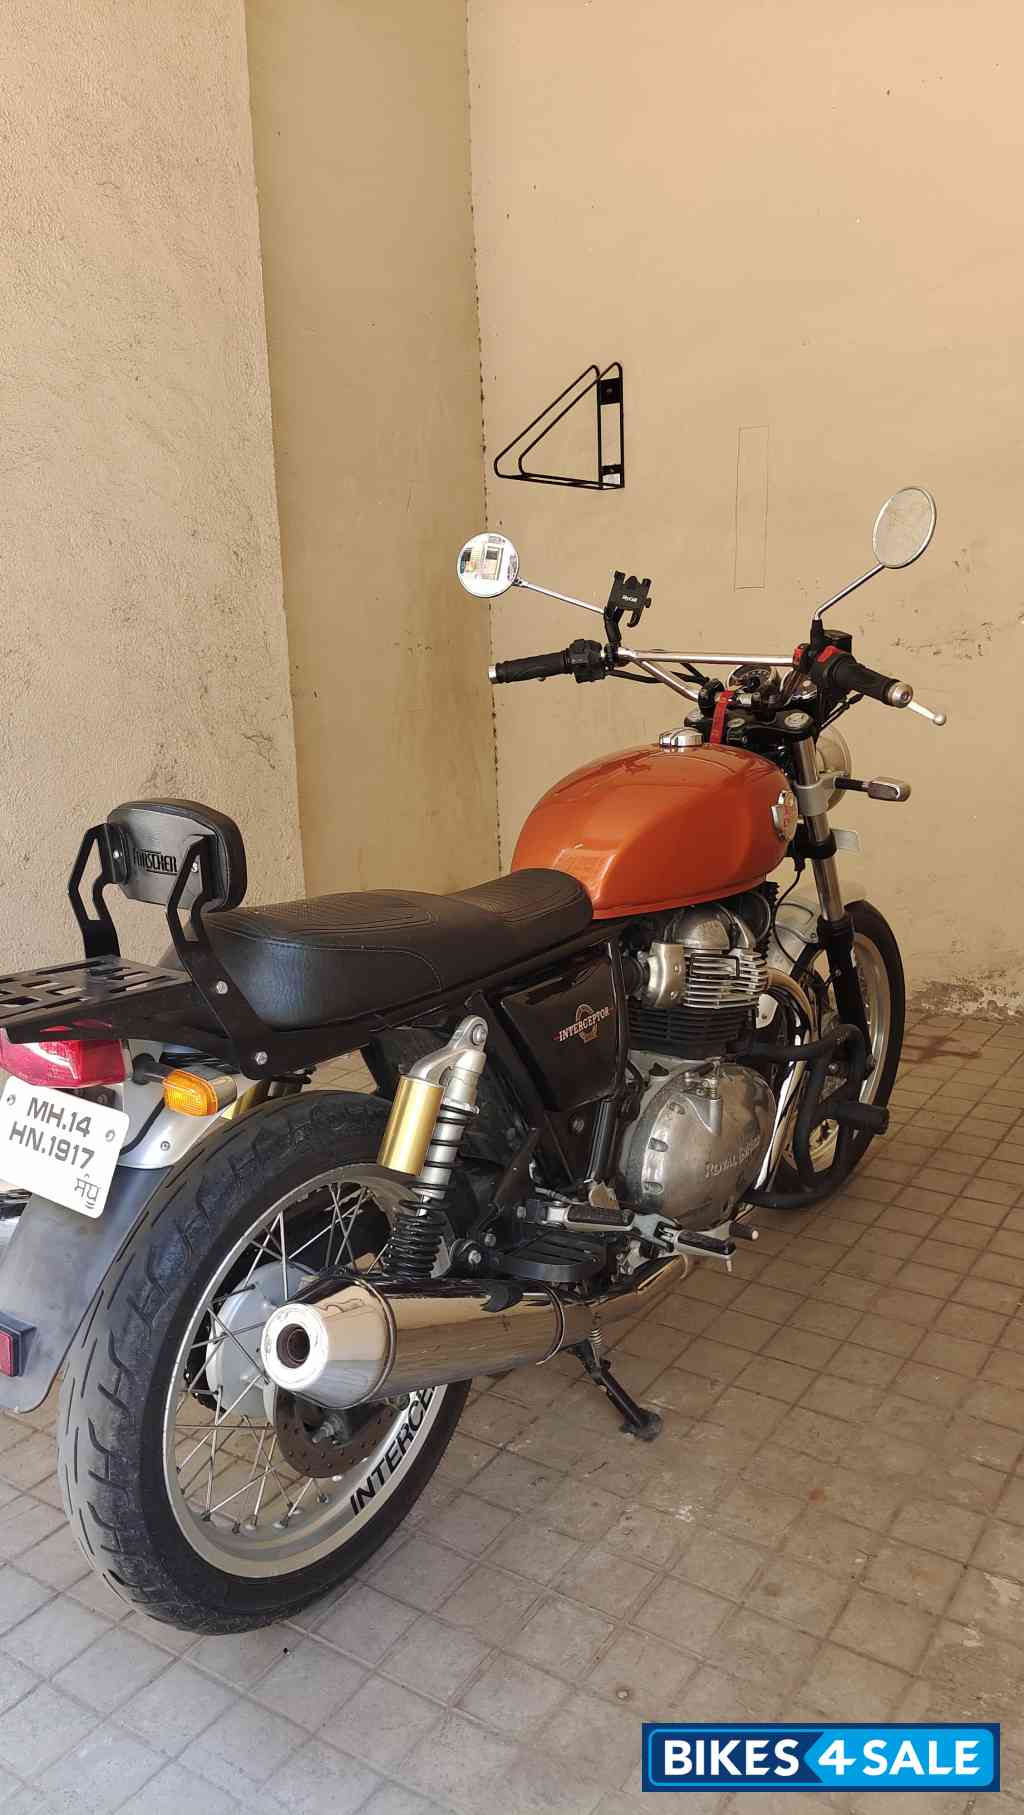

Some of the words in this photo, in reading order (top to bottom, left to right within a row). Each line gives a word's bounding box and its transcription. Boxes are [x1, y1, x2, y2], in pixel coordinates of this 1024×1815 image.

[559, 1006, 609, 1042] INTERCEPTOR
[27, 1097, 92, 1138] MH.14
[9, 1121, 95, 1169] HN.1917
